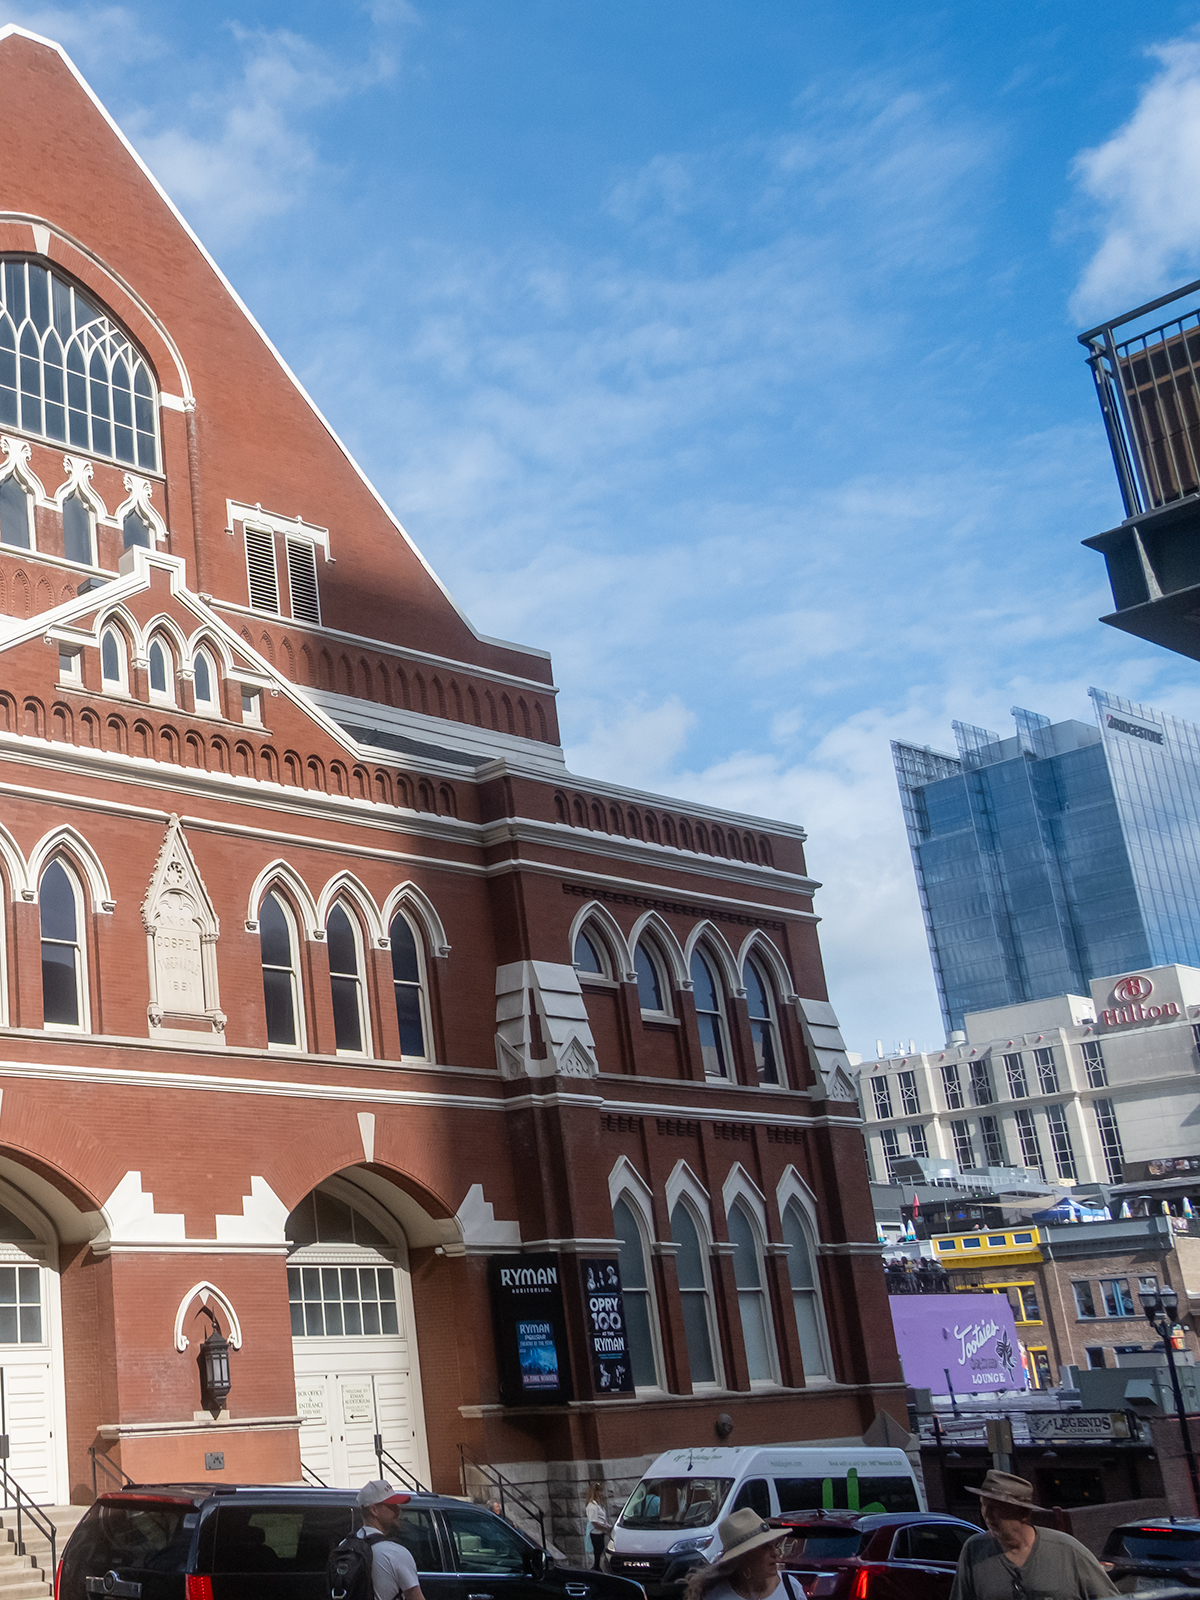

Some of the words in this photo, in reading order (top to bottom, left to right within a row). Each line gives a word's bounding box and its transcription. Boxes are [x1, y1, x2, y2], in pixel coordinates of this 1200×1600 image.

[157, 935, 198, 951] GOSPEL
[1103, 1002, 1182, 1026] Hilton
[500, 1267, 558, 1286] RYMAN
[589, 1297, 618, 1312] OPRY
[520, 1323, 550, 1334] RYMAN
[591, 1312, 622, 1330] 100
[593, 1337, 625, 1352] RYMAN
[953, 1319, 1000, 1365] Tootsies
[971, 1373, 1006, 1384] LOUNGE
[1052, 1416, 1111, 1430] LEGENDS
[623, 1560, 650, 1568] RAM
